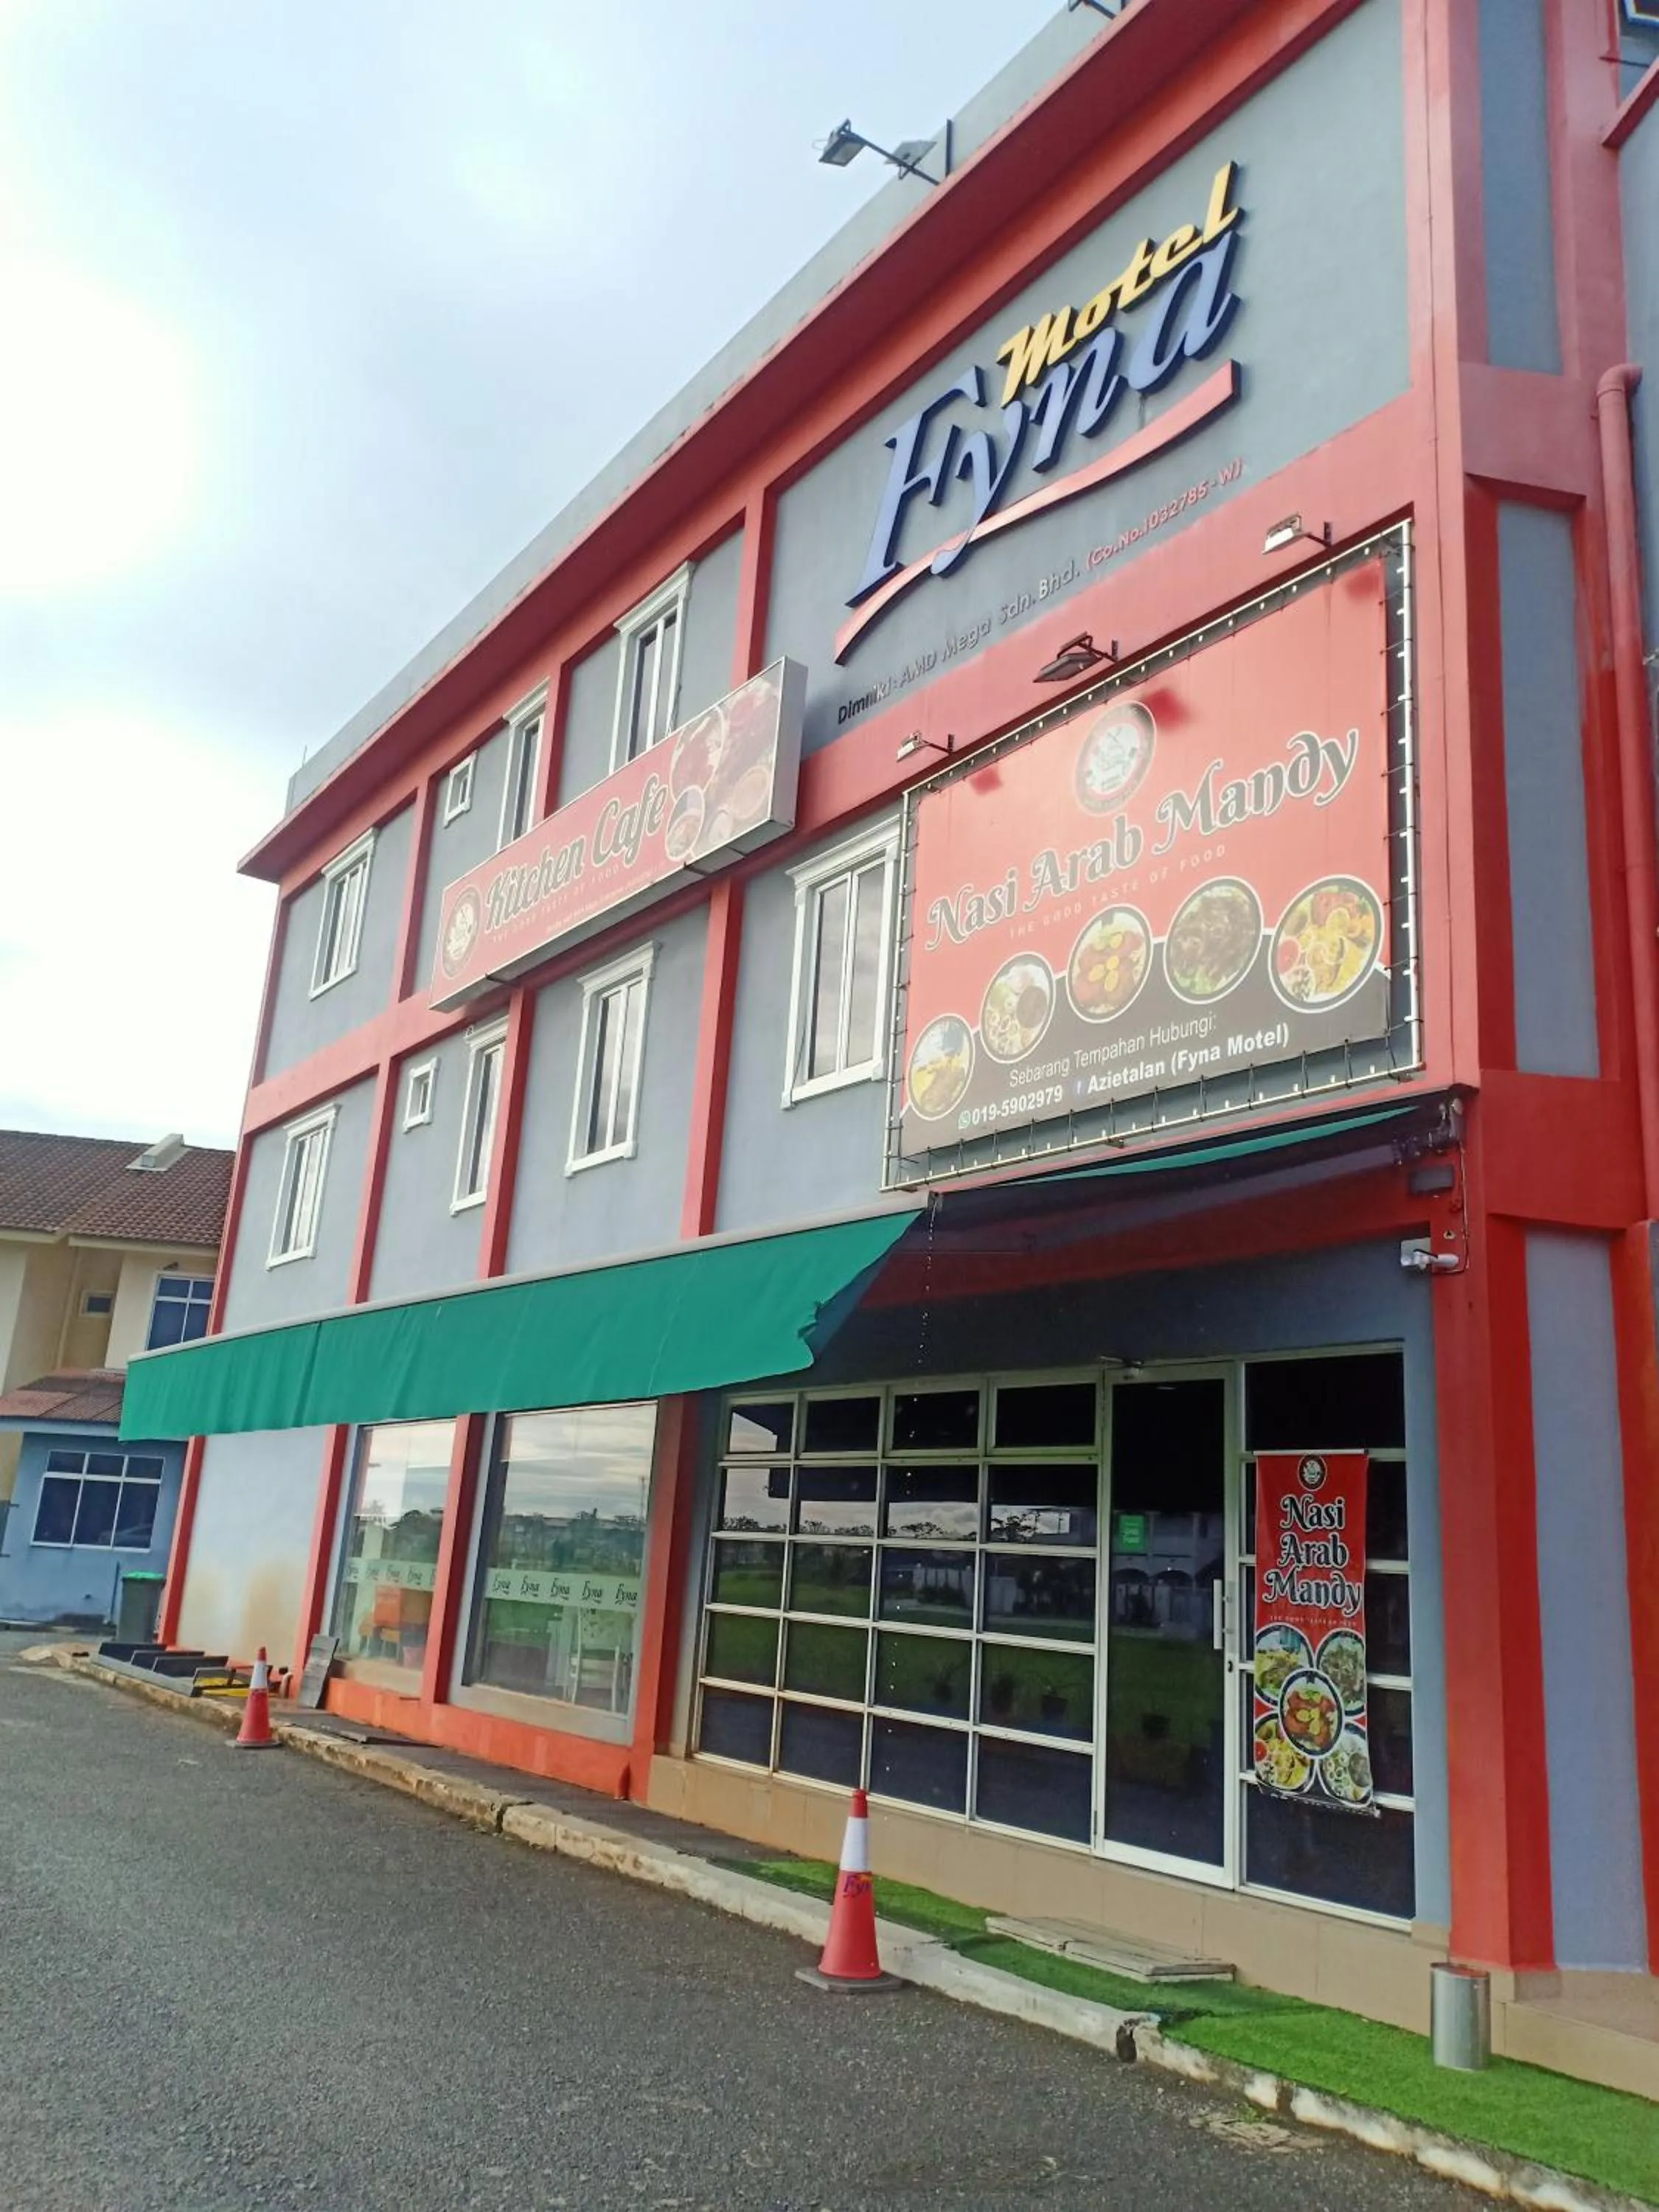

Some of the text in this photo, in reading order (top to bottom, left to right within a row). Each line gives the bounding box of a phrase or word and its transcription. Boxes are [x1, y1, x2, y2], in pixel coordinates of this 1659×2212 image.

[998, 161, 1245, 408] Motel
[846, 232, 1240, 608] Fyna
[942, 619, 992, 663] Mega
[1000, 593, 1037, 625] Sdn.
[1038, 560, 1081, 601] Bhd.
[485, 835, 587, 934] Kitchen
[925, 728, 1359, 950] Nasi Arab Mandy
[1180, 844, 1226, 874] FOOD
[971, 1022, 1290, 1126] 019-5902979 Azietalan (Fyna Motel)
[1009, 1010, 1217, 1088] Sebarang Tempahan Hubungi:
[1278, 1531, 1350, 1568] Arab
[1280, 1493, 1345, 1532] Nasi
[1262, 1565, 1363, 1617] Mandy
